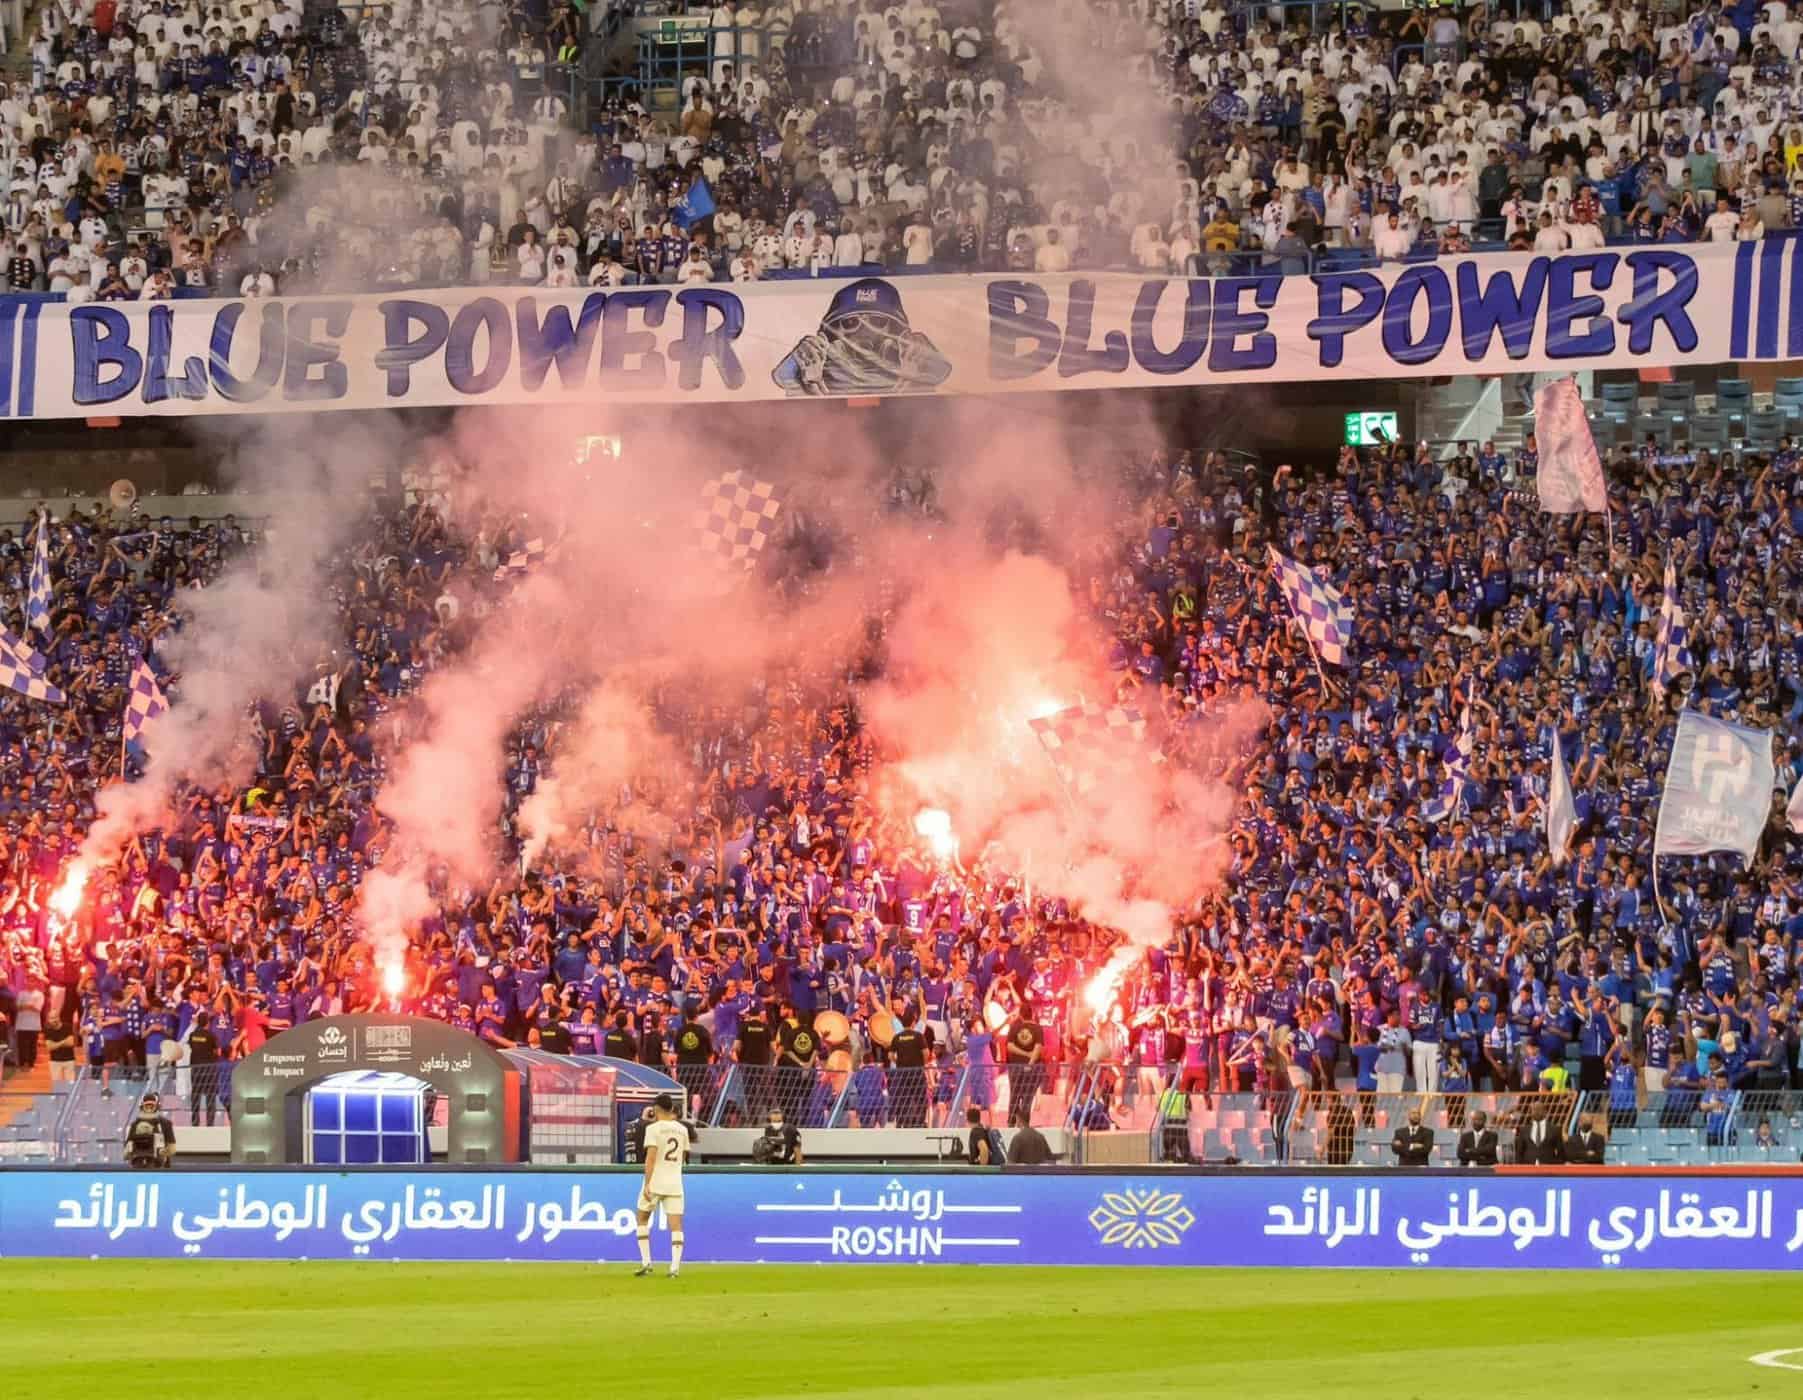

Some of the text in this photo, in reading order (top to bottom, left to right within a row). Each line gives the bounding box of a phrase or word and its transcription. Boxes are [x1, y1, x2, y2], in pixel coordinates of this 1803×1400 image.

[71, 288, 746, 405] BLUE POWER
[987, 250, 1699, 381] BLUE POWER
[263, 1053, 306, 1064] Empower
[263, 1066, 305, 1078] & Impact
[664, 1137, 679, 1162] 2
[54, 1182, 158, 1240] الرائد
[171, 1184, 327, 1254] الوطني
[342, 1185, 504, 1254] العقاري
[831, 1226, 943, 1257] ROSHN
[1263, 1186, 1381, 1248] الرائد
[1397, 1189, 1570, 1262] الوطني
[1588, 1189, 1773, 1264] العقاري
